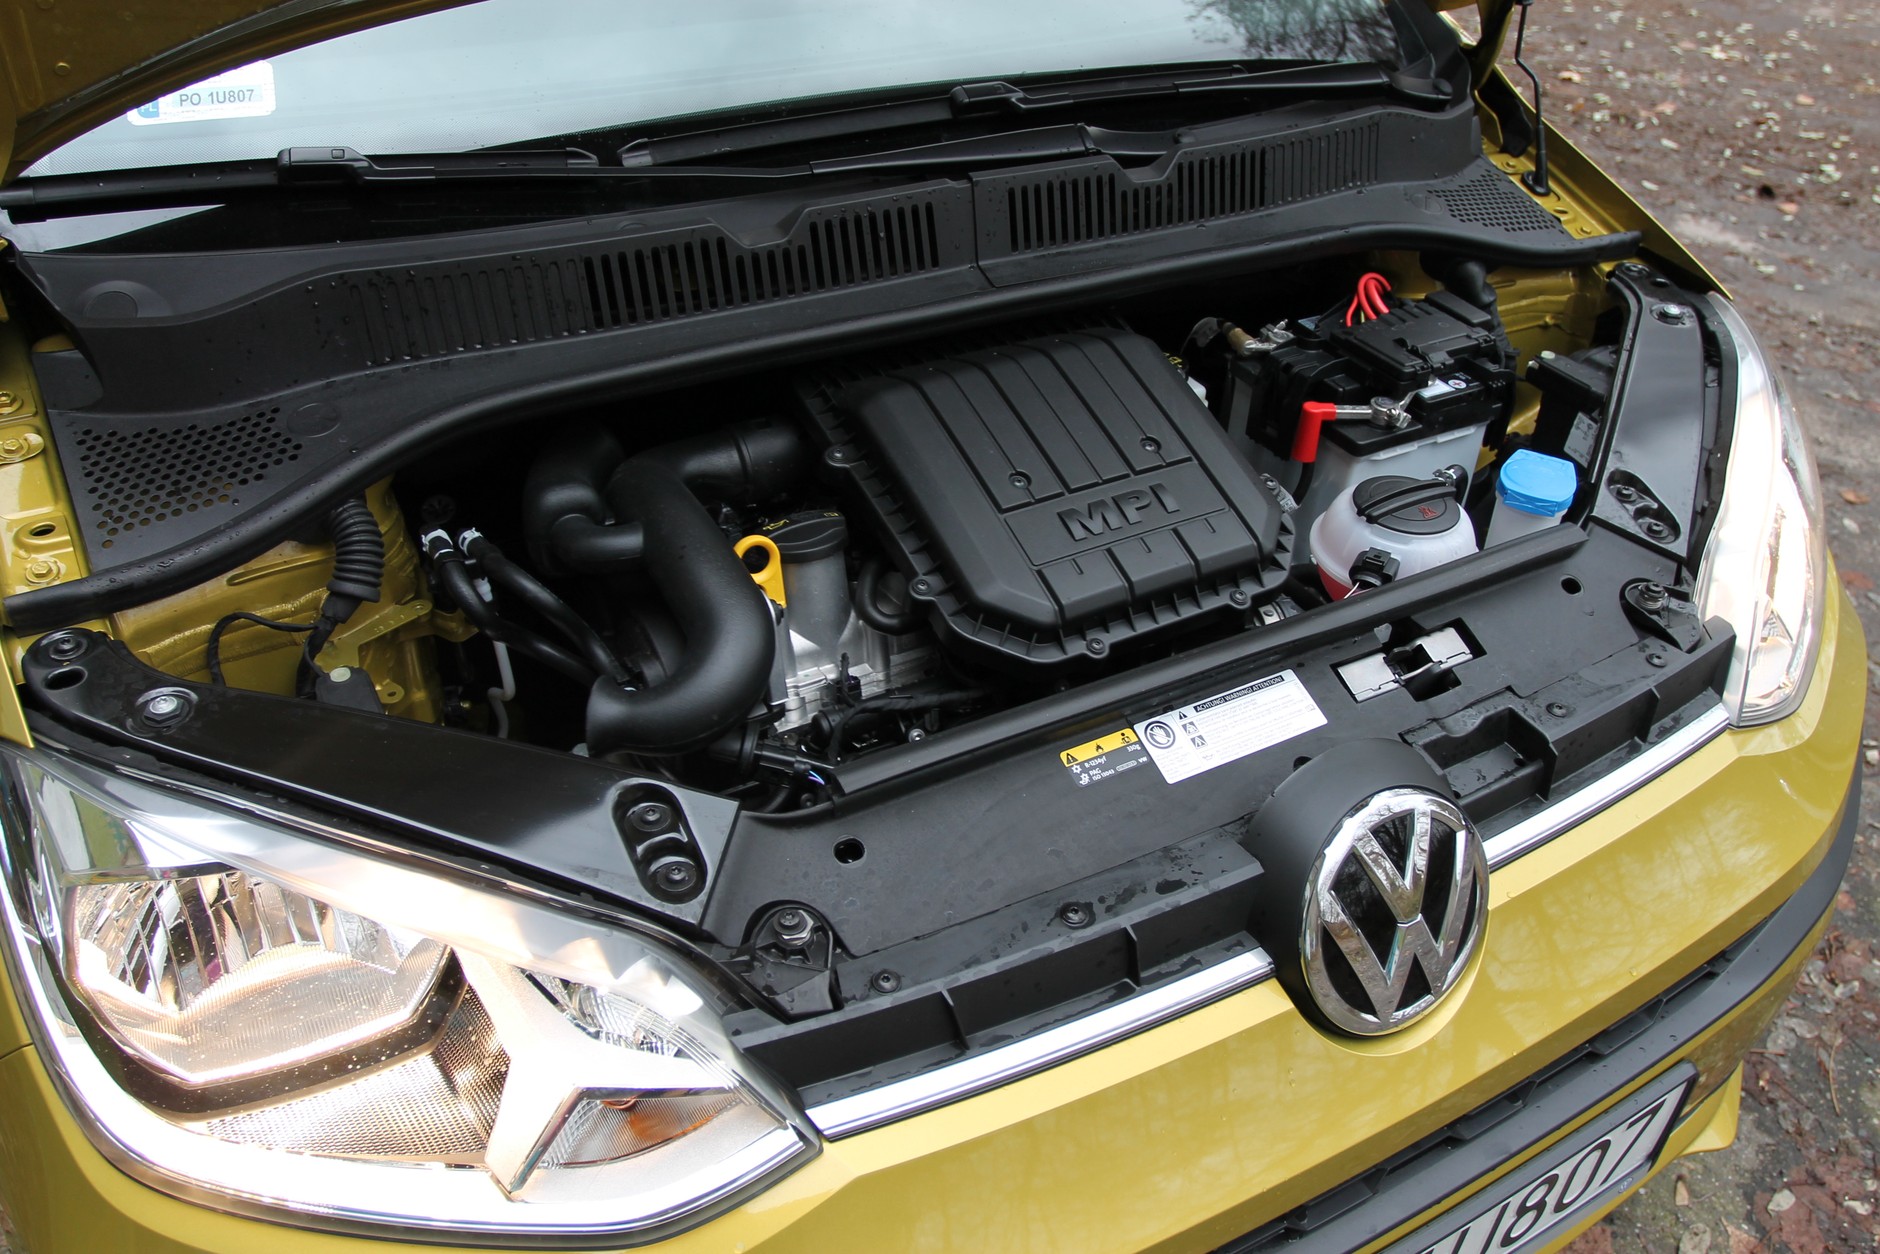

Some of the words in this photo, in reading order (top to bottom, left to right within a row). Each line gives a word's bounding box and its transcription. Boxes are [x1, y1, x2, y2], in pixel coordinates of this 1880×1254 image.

[179, 92, 201, 107] PO
[208, 89, 255, 105] 1U807
[1057, 483, 1180, 541] MPI
[1196, 697, 1225, 712] ACHTUNG!
[1225, 687, 1252, 701] WARNING!
[1252, 676, 1283, 692] ATTENTION!
[1089, 768, 1102, 776] PAG
[1092, 773, 1101, 781] ISO
[1424, 1097, 1667, 1254] 807
